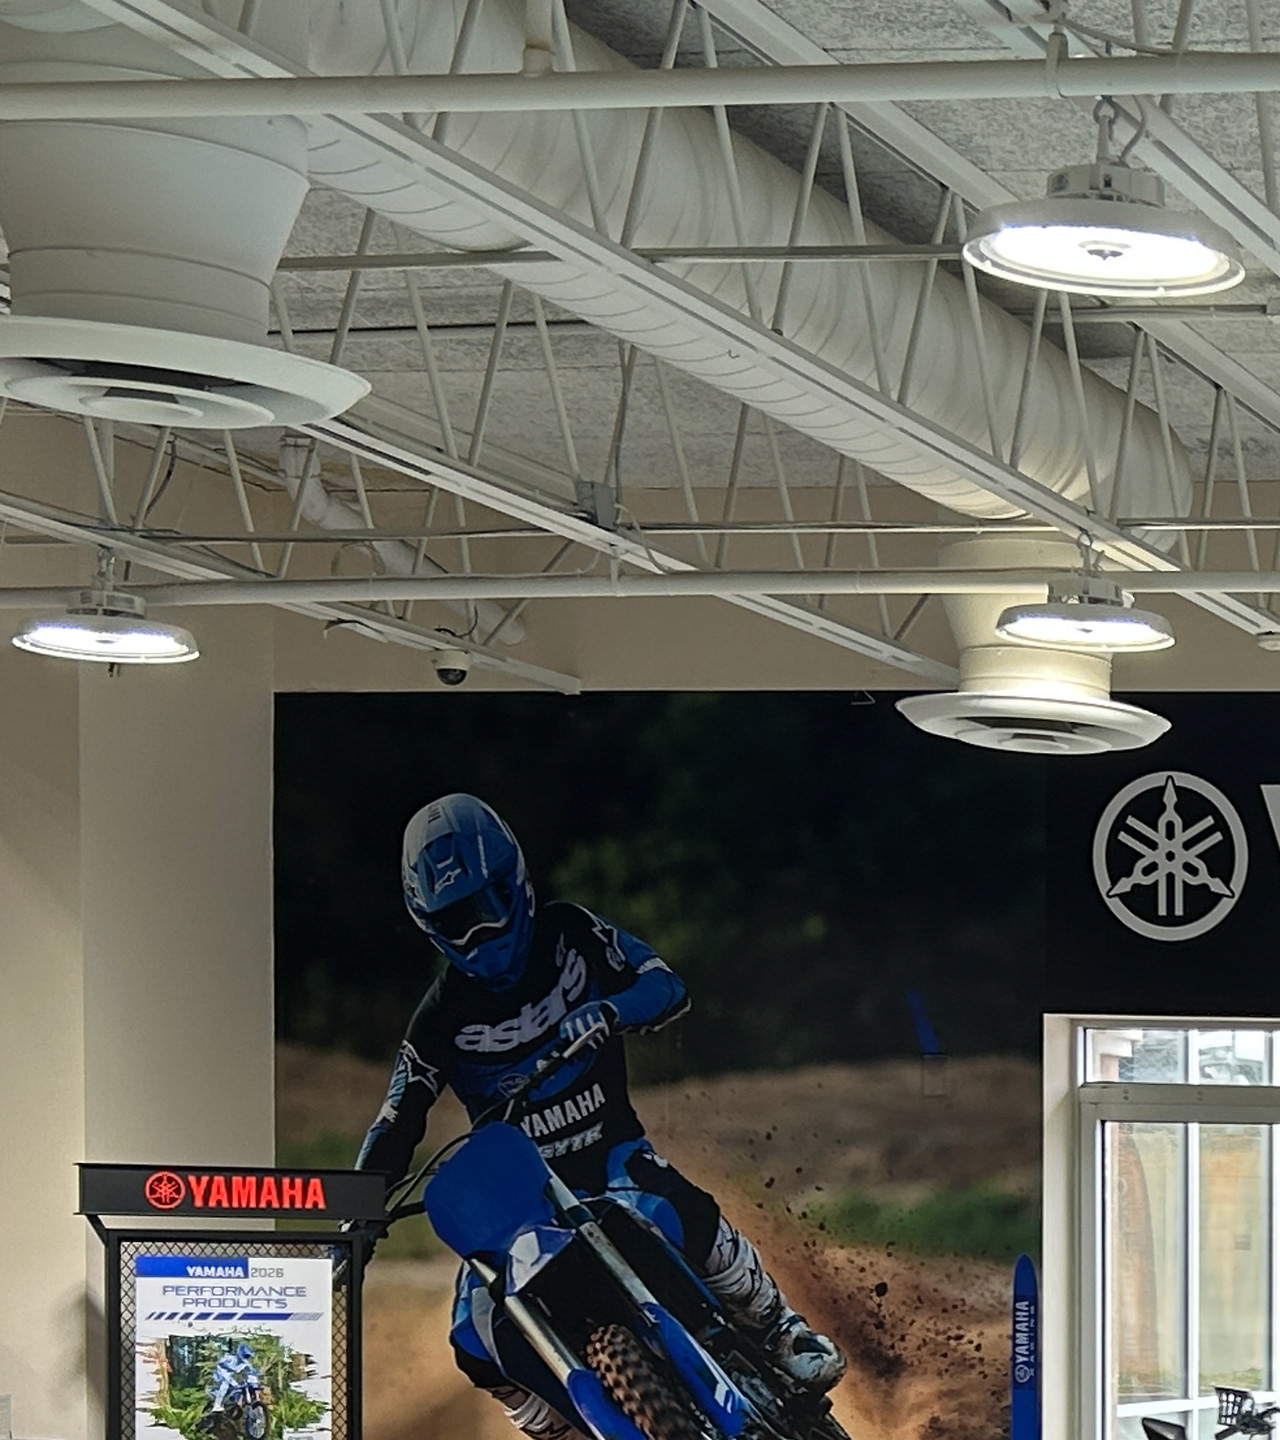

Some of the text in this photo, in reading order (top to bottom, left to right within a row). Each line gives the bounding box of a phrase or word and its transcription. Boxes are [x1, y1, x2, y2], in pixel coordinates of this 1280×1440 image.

[520, 1083, 606, 1138] YAMAHA
[187, 1175, 326, 1209] YAMAHA
[186, 1266, 284, 1278] YAMAHA 2026
[162, 1286, 307, 1297] PERFORMANCE
[182, 1298, 288, 1308] PRODUCTS
[1014, 1300, 1030, 1364] YAMAHA
